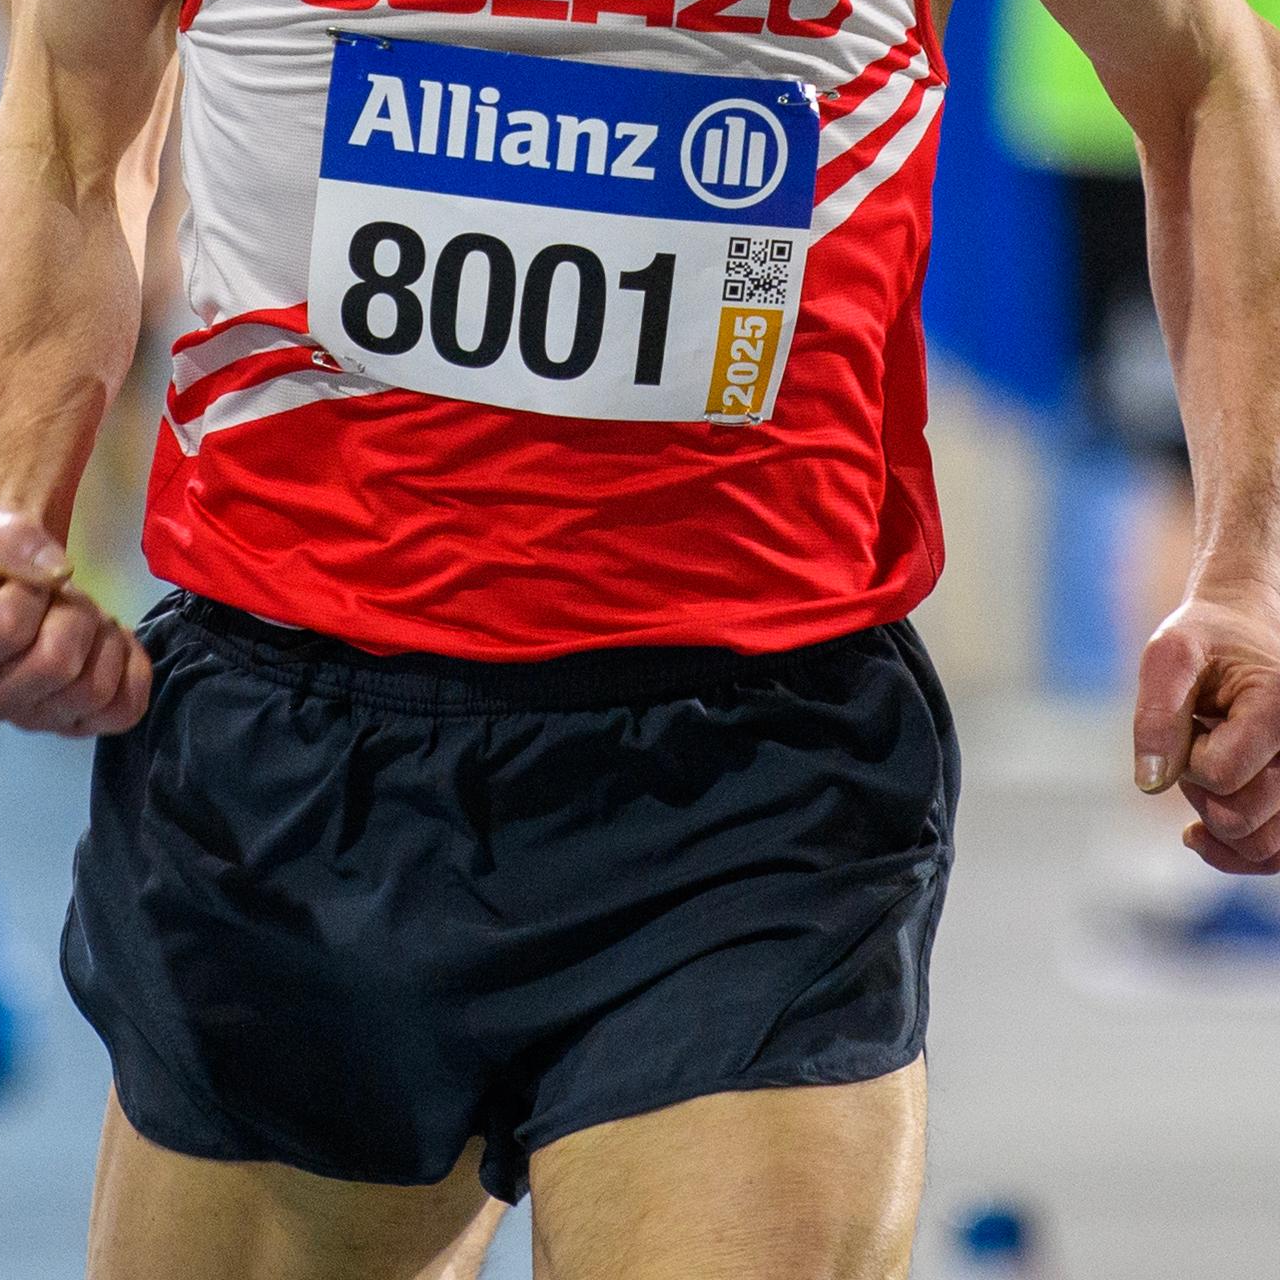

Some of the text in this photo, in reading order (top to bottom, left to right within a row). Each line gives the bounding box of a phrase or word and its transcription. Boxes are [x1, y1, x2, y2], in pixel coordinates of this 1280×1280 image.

[348, 73, 659, 181] Allianz
[340, 221, 677, 386] 8001
[722, 314, 768, 408] 2025
